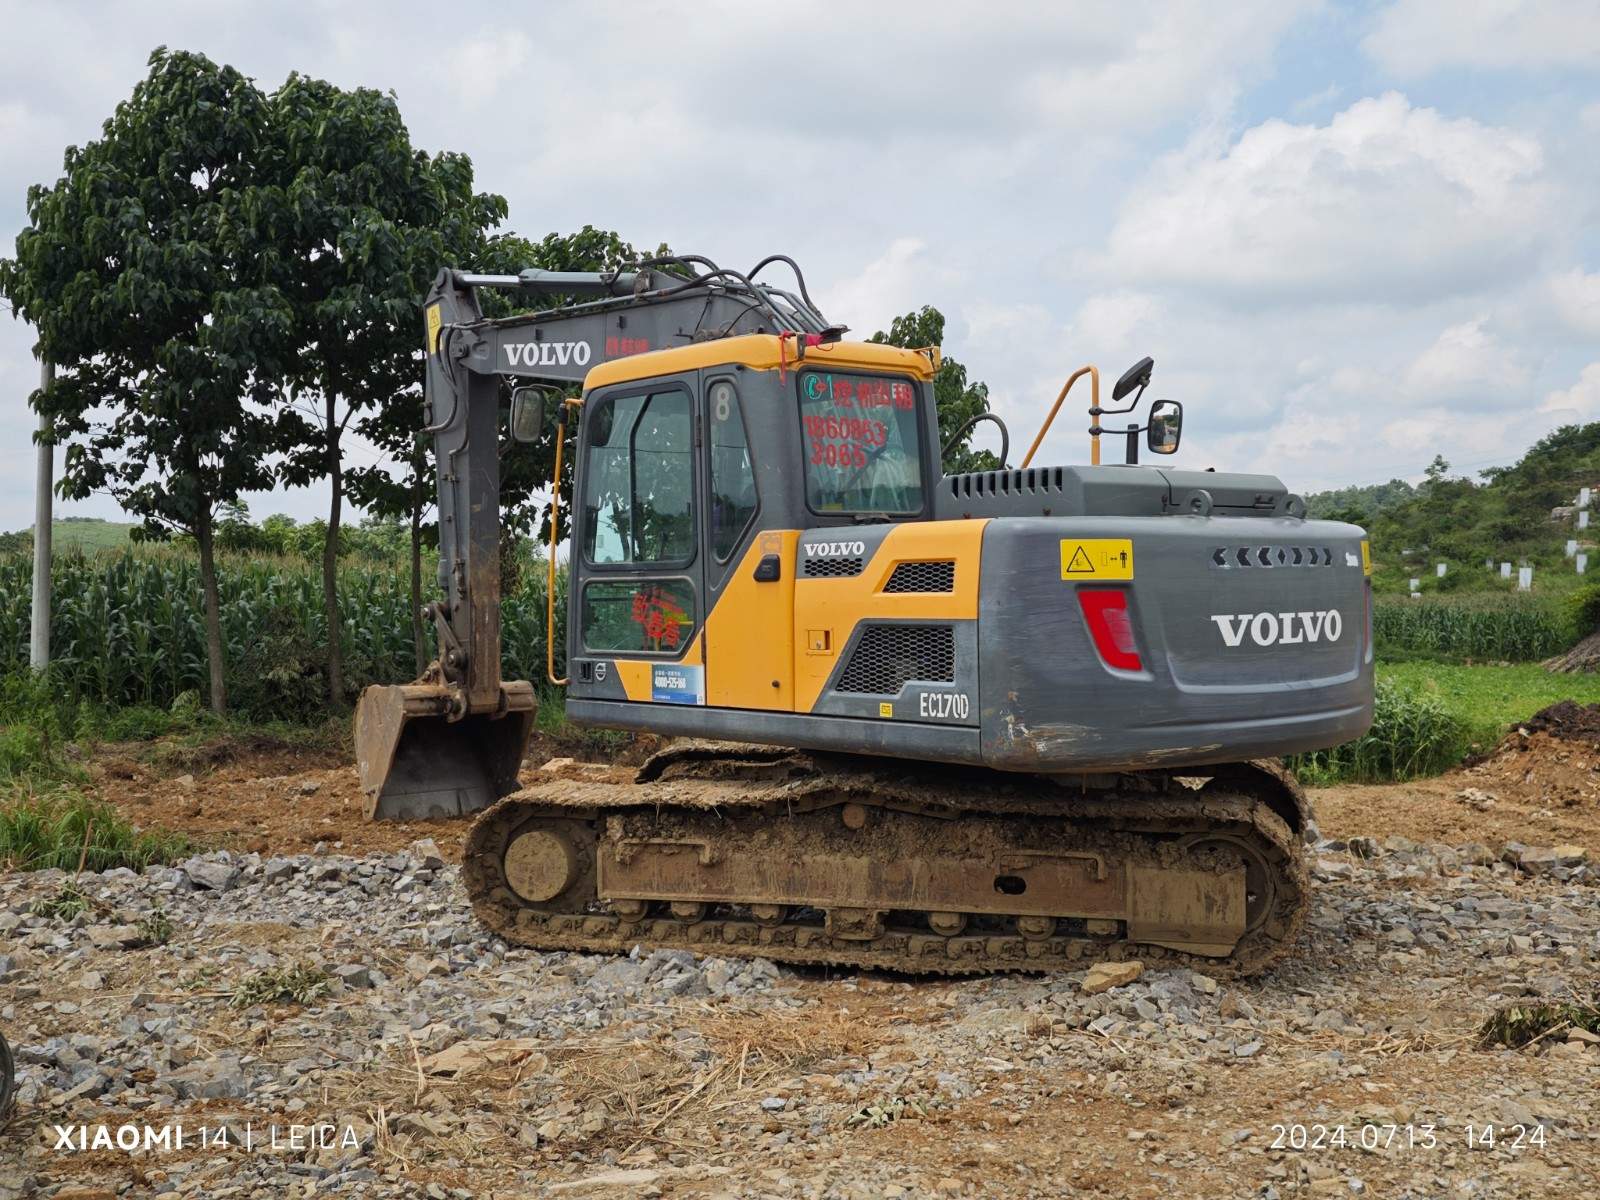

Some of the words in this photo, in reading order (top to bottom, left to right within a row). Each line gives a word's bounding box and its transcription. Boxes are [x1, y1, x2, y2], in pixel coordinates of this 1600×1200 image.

[503, 341, 591, 366] VOLVO
[717, 387, 729, 421] 8
[804, 541, 865, 556] VOLVO
[1211, 609, 1342, 646] VOLVO
[920, 692, 969, 719] EC170D
